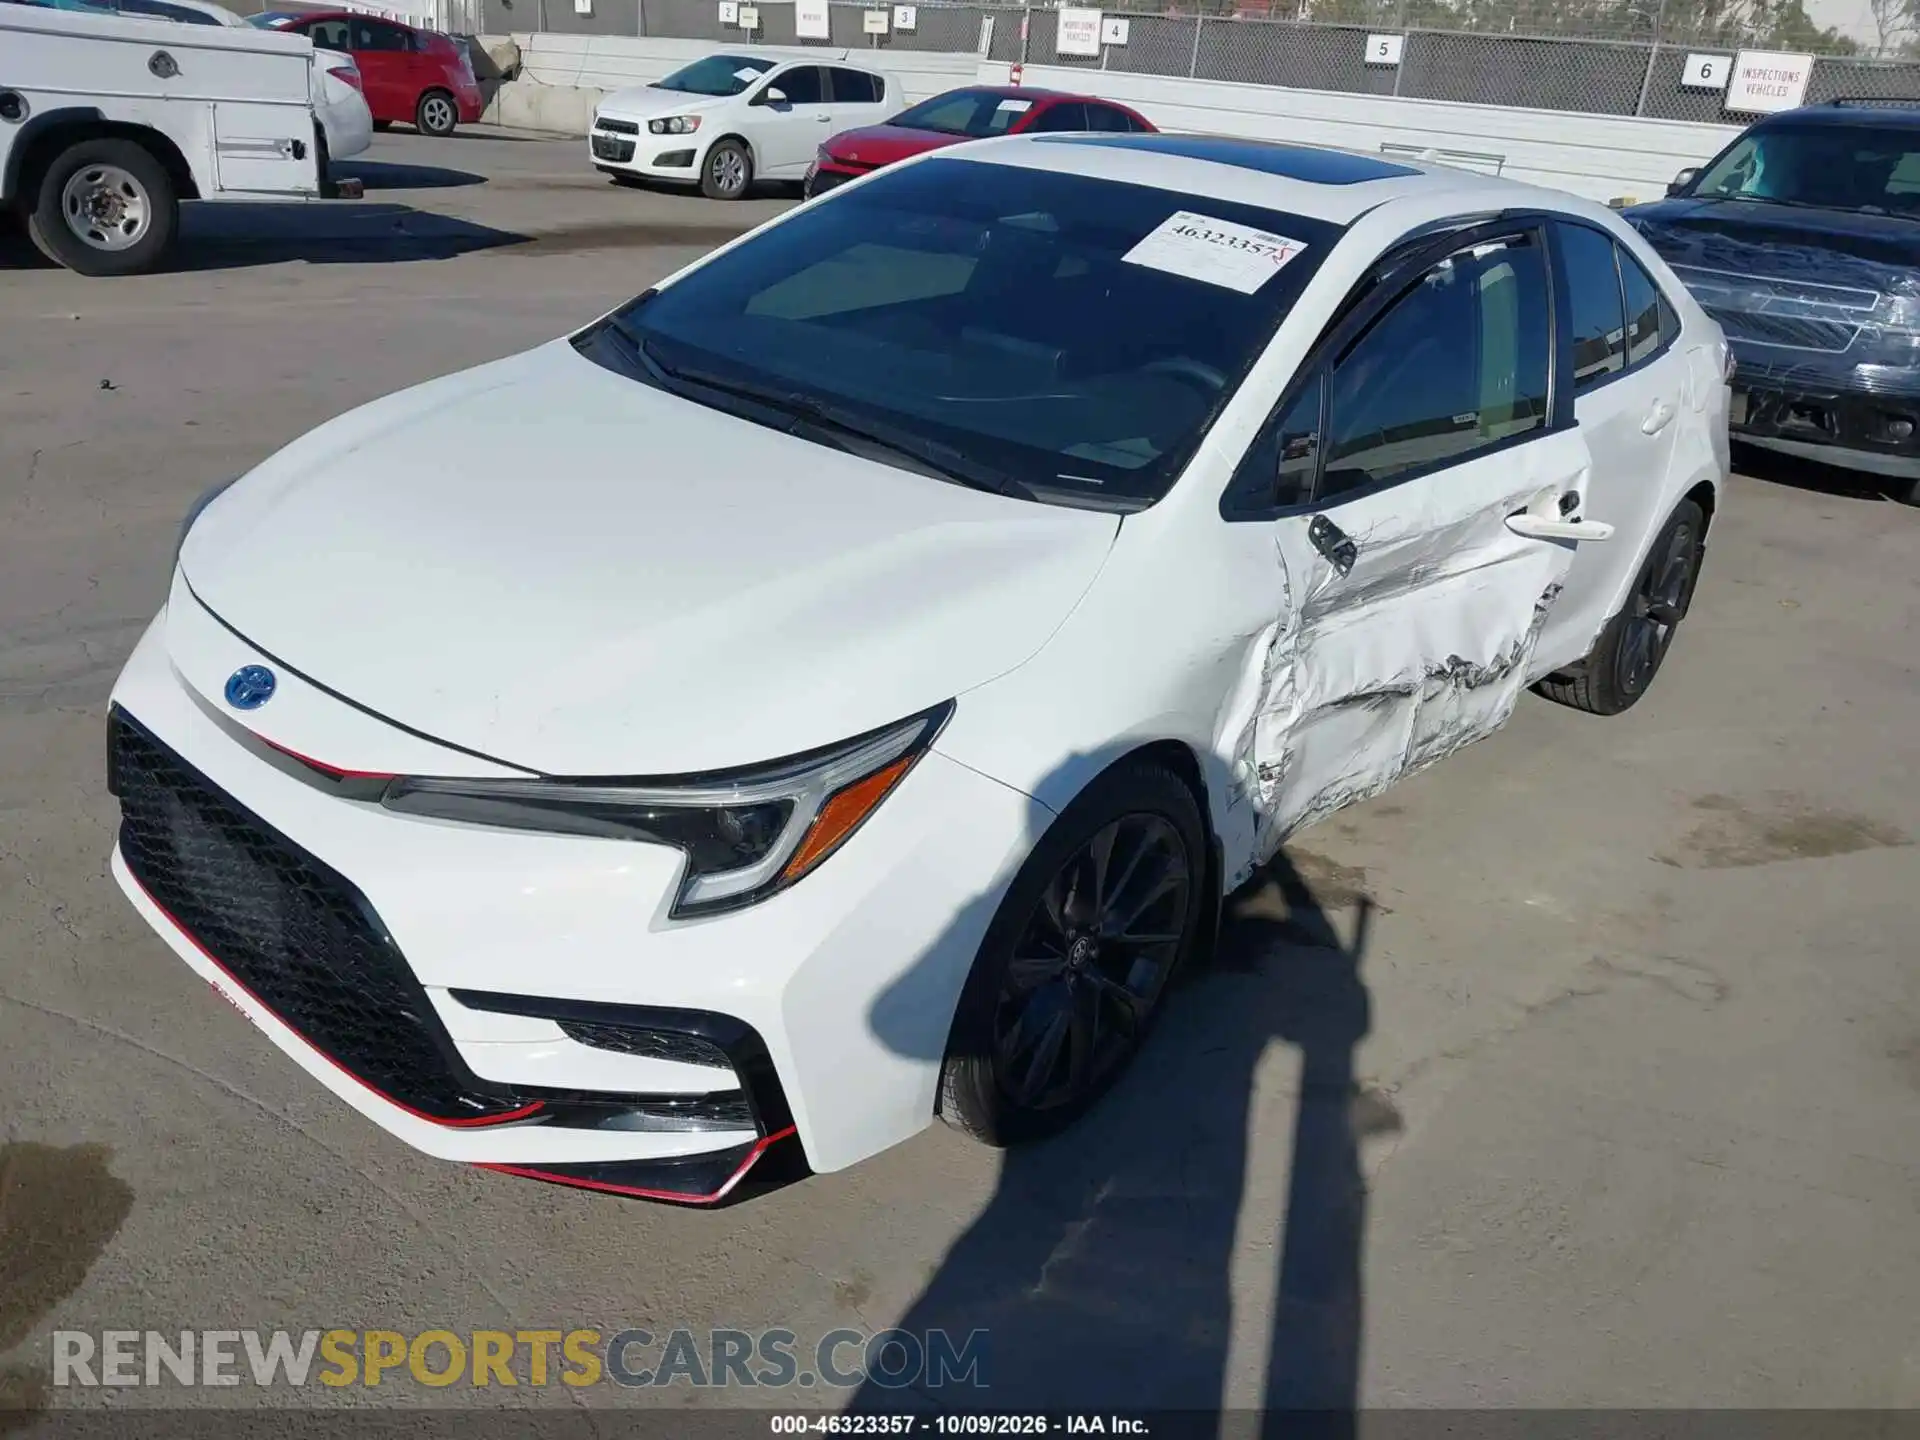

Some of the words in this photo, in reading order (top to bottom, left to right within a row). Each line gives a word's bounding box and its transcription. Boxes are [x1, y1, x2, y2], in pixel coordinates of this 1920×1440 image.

[725, 6, 732, 18] 2
[902, 11, 909, 23] 3
[1112, 25, 1119, 37] 4
[1379, 42, 1389, 56] 5
[1700, 63, 1713, 79] 6
[1742, 67, 1801, 82] INSPECTIONS
[1746, 84, 1789, 97] VEHICLES
[1171, 224, 1278, 259] 46323357
